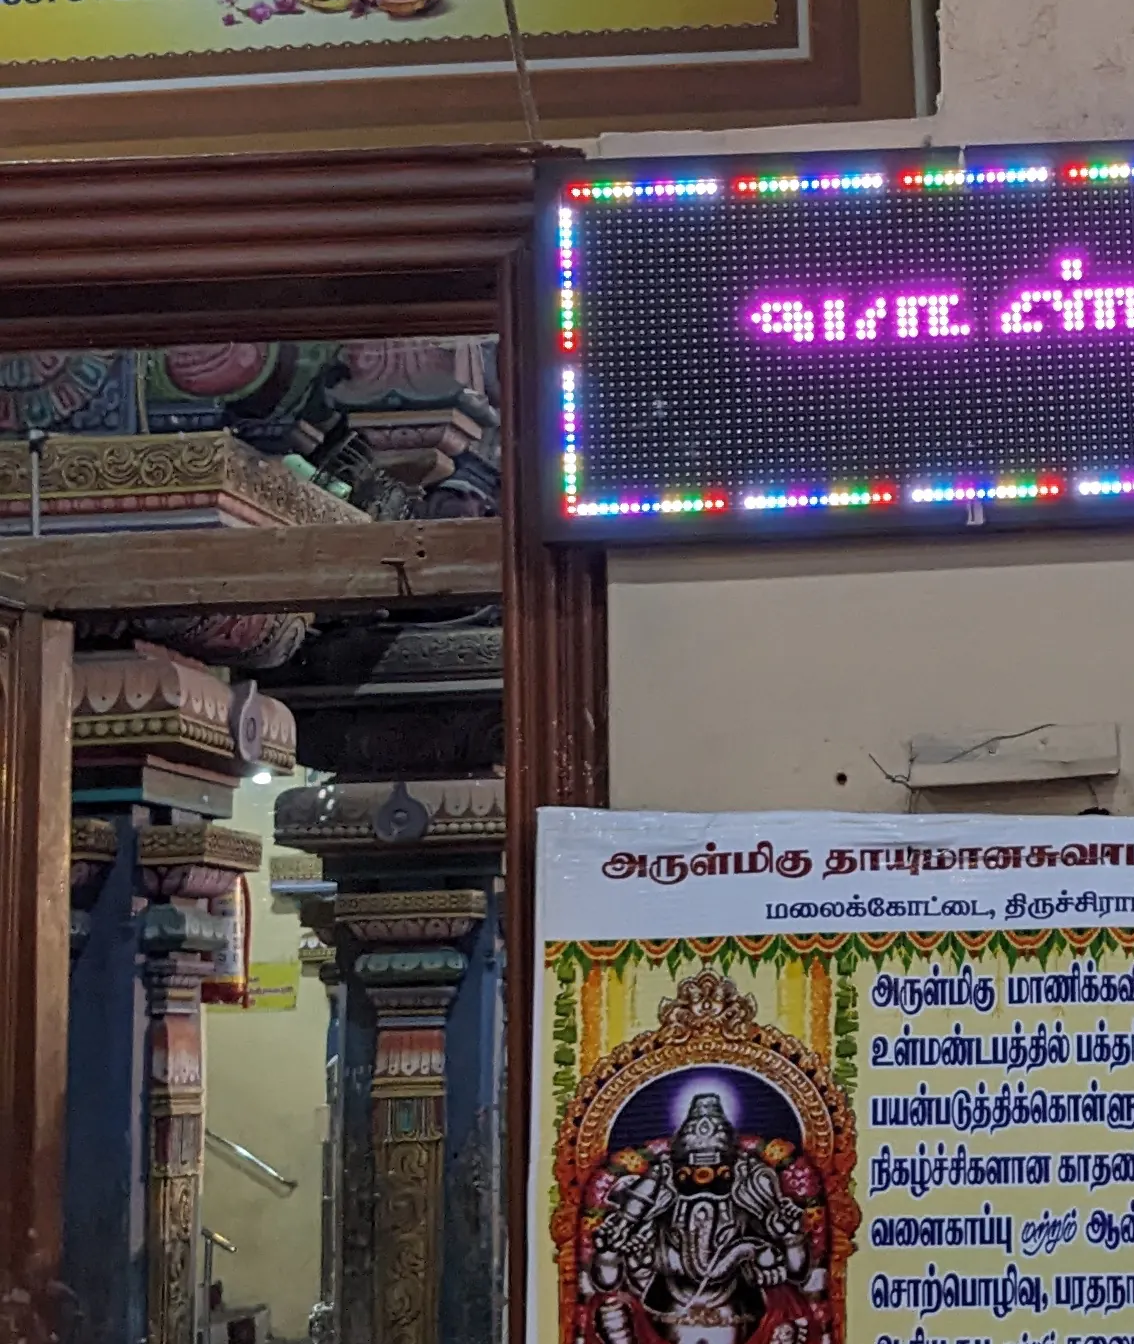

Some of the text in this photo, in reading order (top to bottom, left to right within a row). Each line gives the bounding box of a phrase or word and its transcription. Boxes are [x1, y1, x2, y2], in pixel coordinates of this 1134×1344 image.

[602, 840, 813, 882] அருள்மிகு
[765, 894, 994, 922] மலைக்கோட்டை,
[872, 965, 993, 1014] அருள்மிகு
[872, 1023, 1067, 1073] உள்மண்டபத்தில்
[870, 1140, 1050, 1195] நிகழ்ச்சிகளான
[872, 1204, 1012, 1251] வளைகாப்பு
[872, 1266, 1048, 1316] சொற்பொழிவு,
